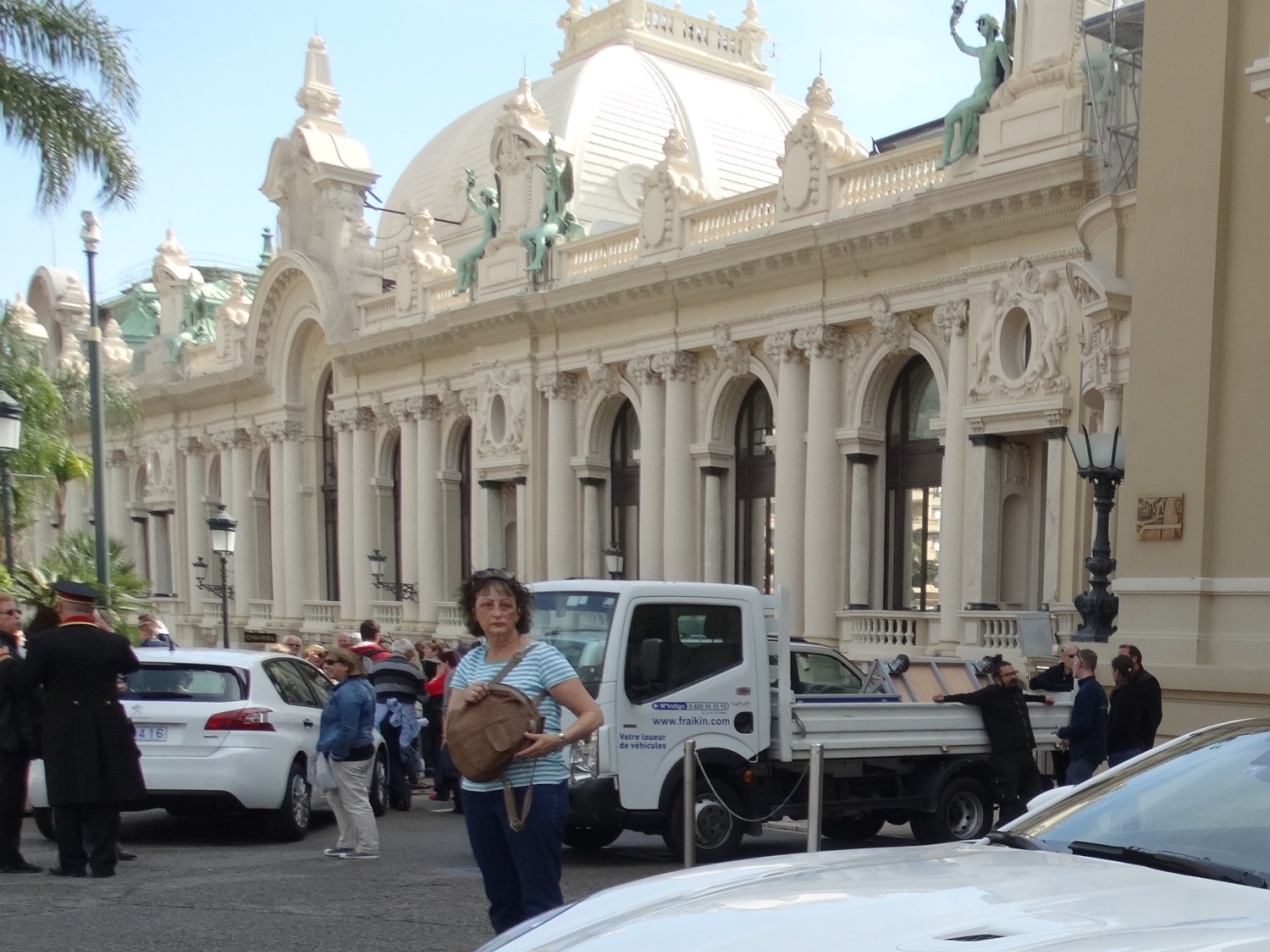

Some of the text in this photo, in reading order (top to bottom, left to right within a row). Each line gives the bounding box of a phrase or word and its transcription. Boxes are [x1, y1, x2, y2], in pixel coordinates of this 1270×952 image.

[652, 716, 730, 726] www.fraikin.com
[619, 733, 666, 741] Votre loueur
[630, 741, 667, 749] véhicules
